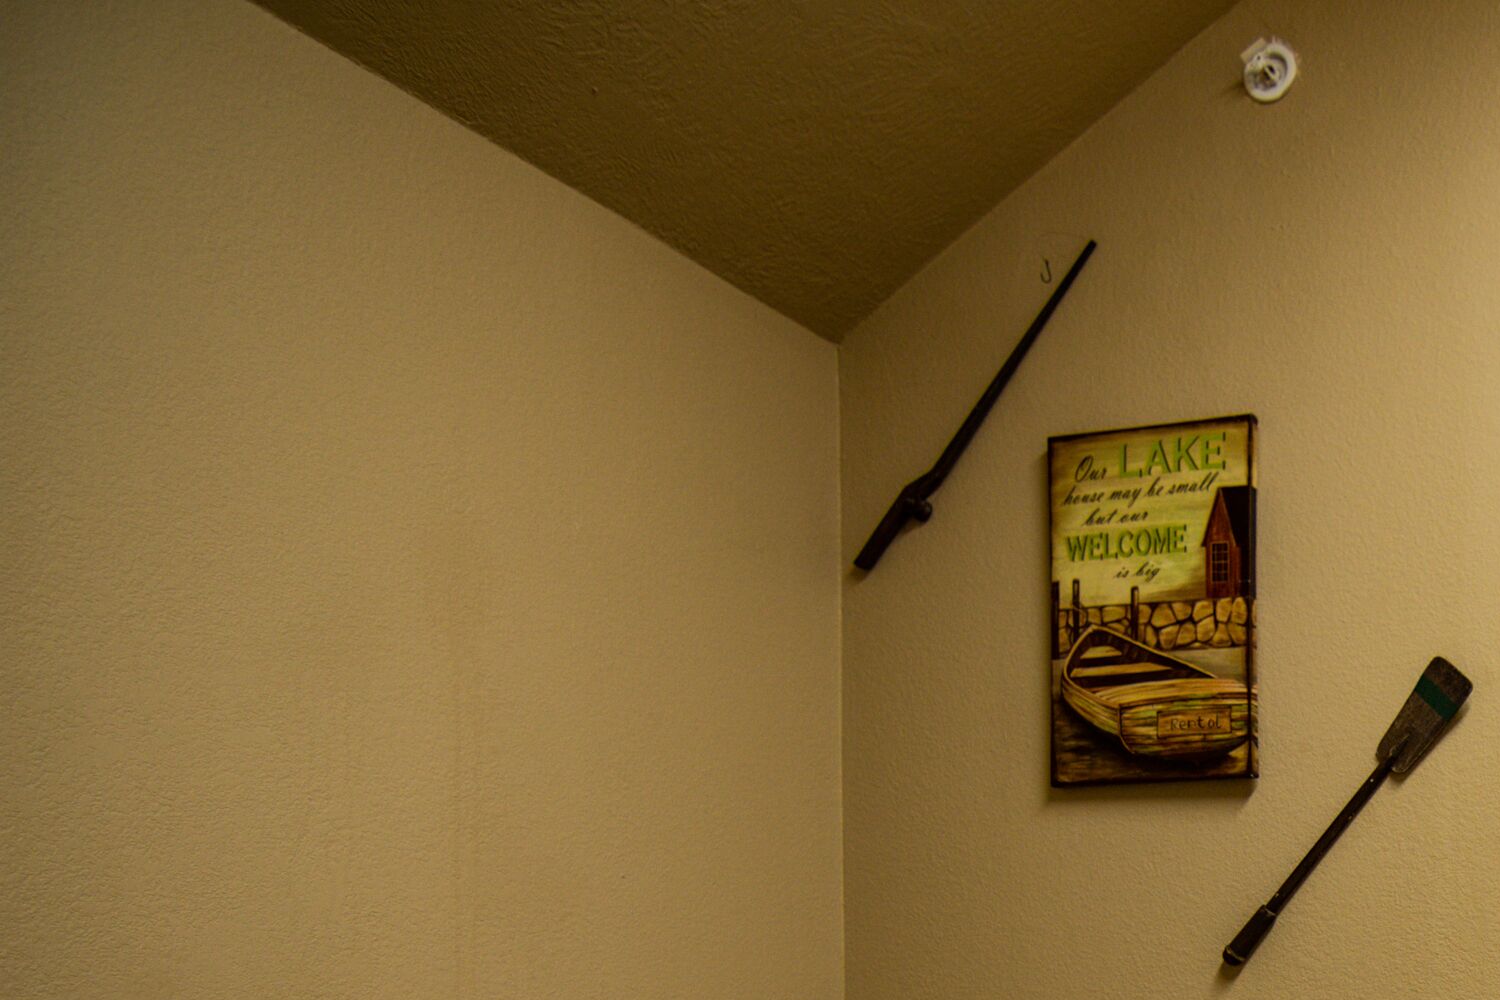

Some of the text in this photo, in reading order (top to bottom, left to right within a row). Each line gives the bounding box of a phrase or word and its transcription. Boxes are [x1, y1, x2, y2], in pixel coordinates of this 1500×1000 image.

[1074, 431, 1226, 483] Our LAKE
[1062, 472, 1219, 509] house may be small
[1082, 508, 1148, 527] but our
[1065, 524, 1187, 562] WELCOME
[1113, 561, 1160, 583] is big
